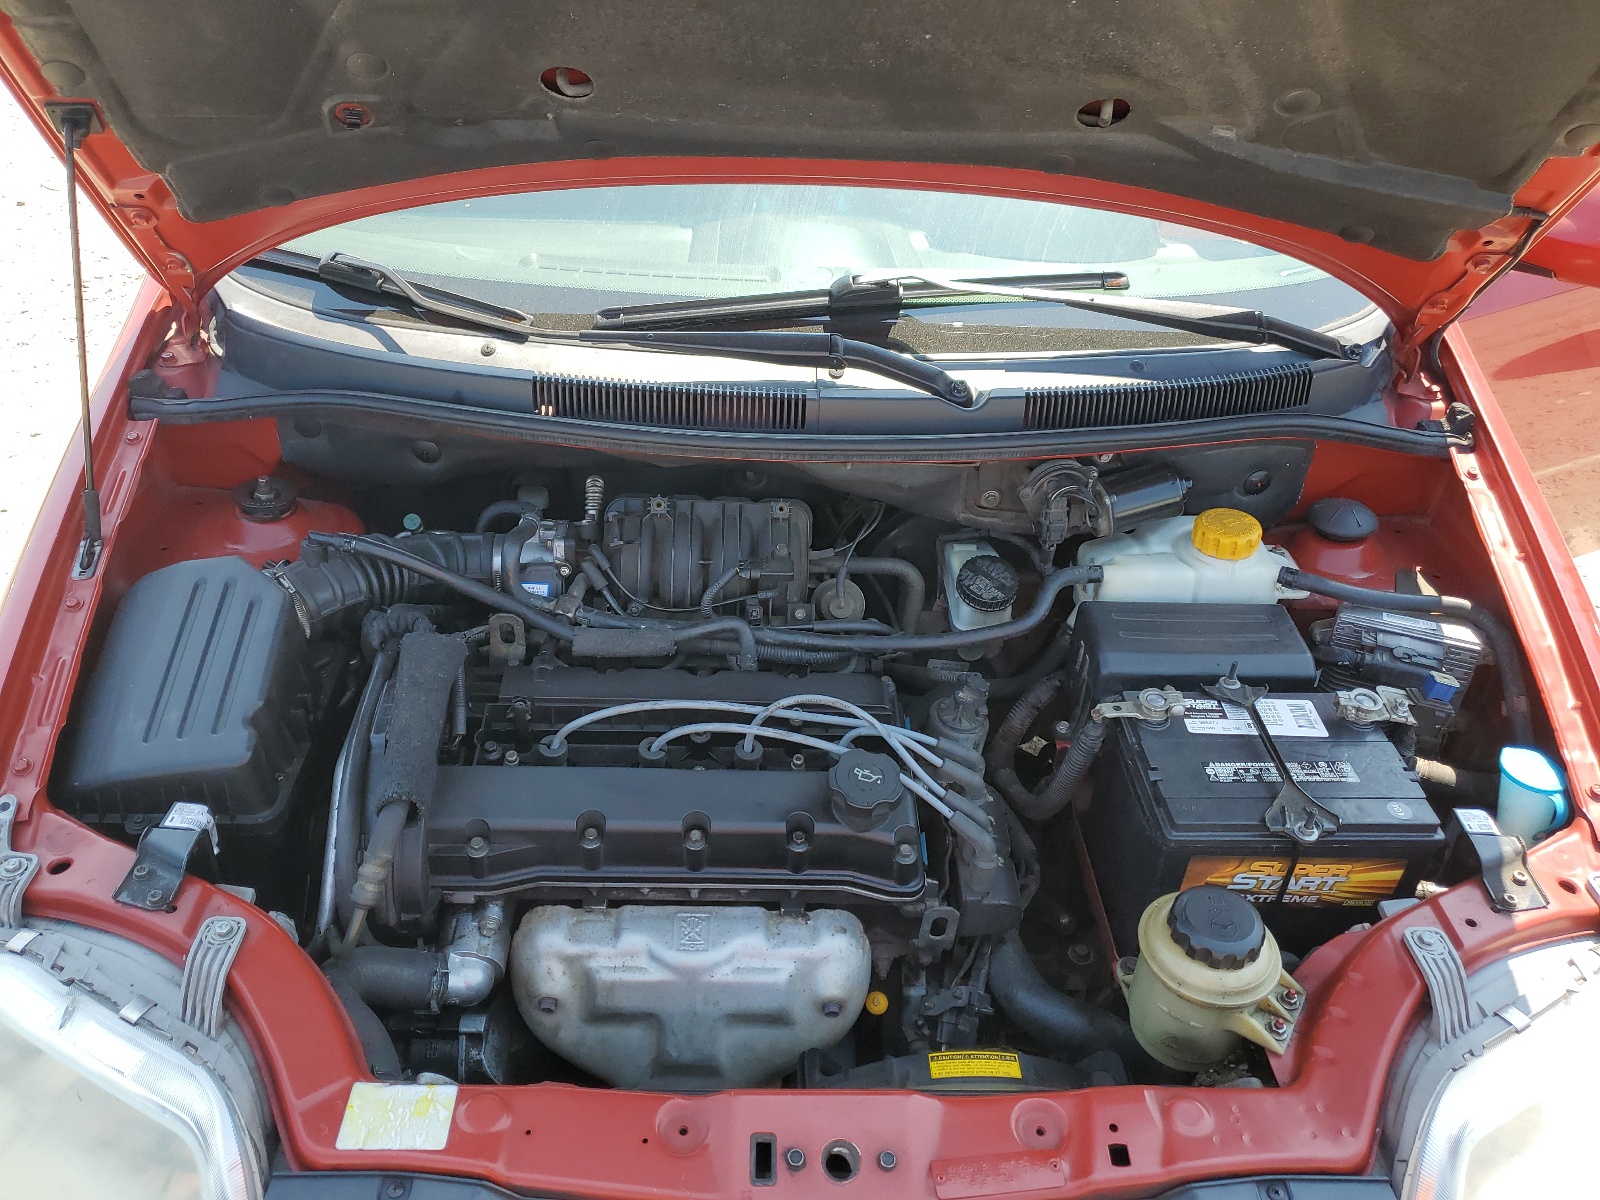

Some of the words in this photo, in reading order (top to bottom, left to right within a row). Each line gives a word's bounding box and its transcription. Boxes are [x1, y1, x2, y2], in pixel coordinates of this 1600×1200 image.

[1249, 861, 1353, 877] SUPER
[1226, 873, 1348, 891] START
[1241, 894, 1322, 904] XTREME
